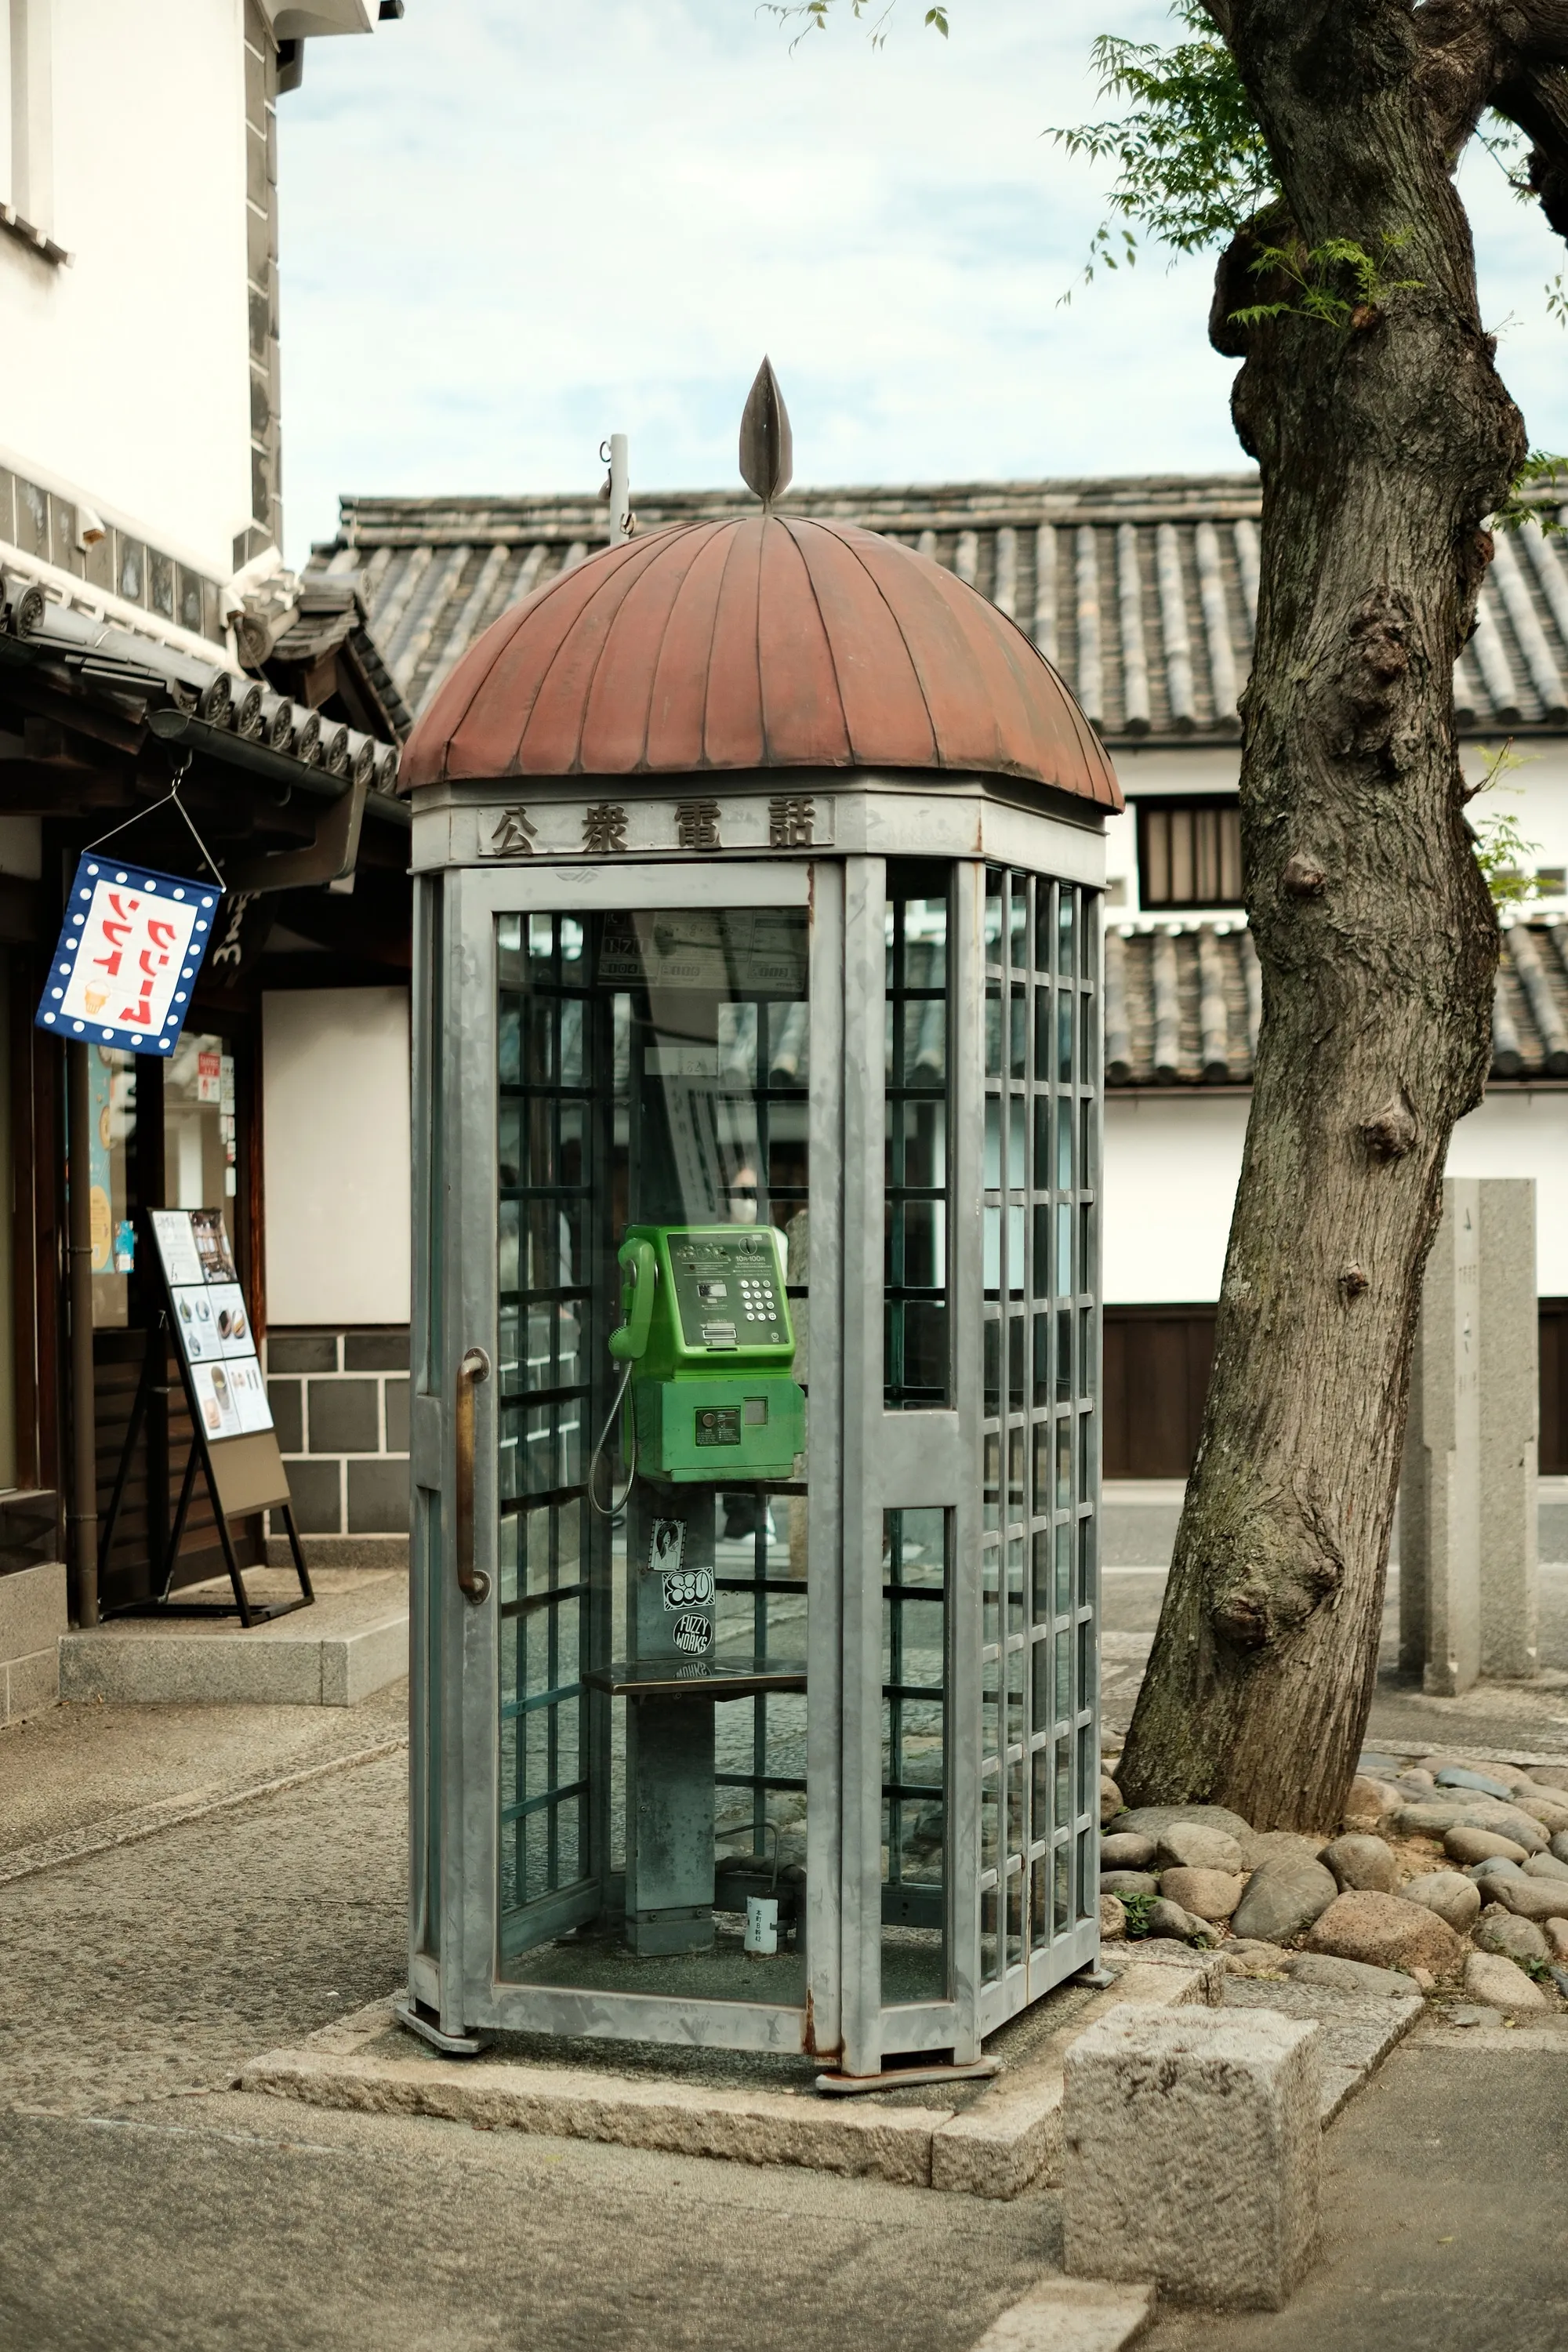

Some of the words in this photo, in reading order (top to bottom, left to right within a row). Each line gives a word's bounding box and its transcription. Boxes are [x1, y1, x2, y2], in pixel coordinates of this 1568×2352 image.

[491, 795, 816, 857] 公衆電話
[680, 1614, 709, 1635] FUZZY
[676, 1632, 708, 1653] WORKS
